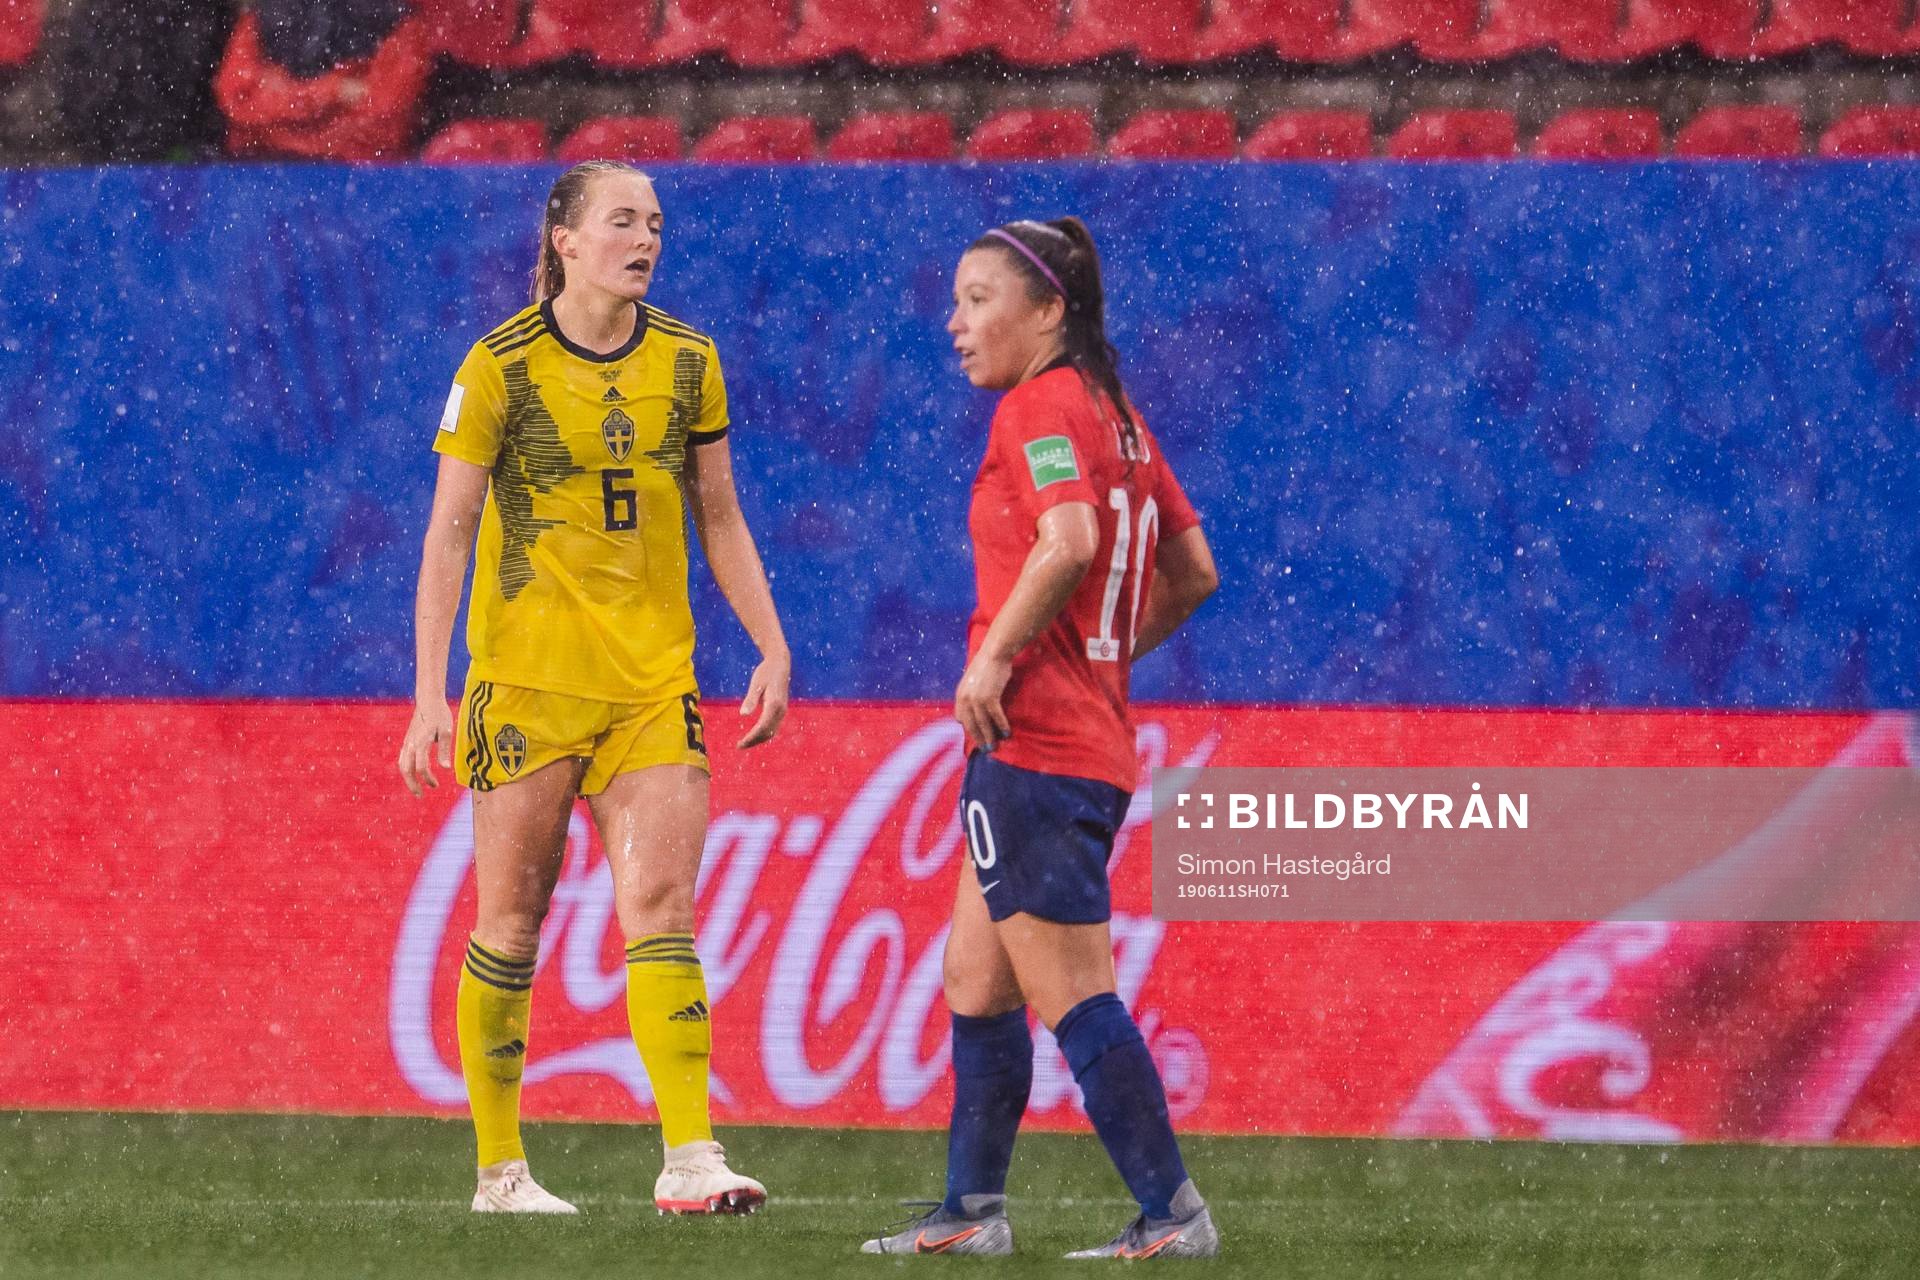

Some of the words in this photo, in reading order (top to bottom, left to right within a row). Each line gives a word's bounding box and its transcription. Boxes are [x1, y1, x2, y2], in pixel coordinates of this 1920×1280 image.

[601, 468, 637, 532] 6
[1087, 487, 1159, 662] 10
[960, 799, 997, 871] 0
[387, 716, 1222, 1113] Cca-Co
